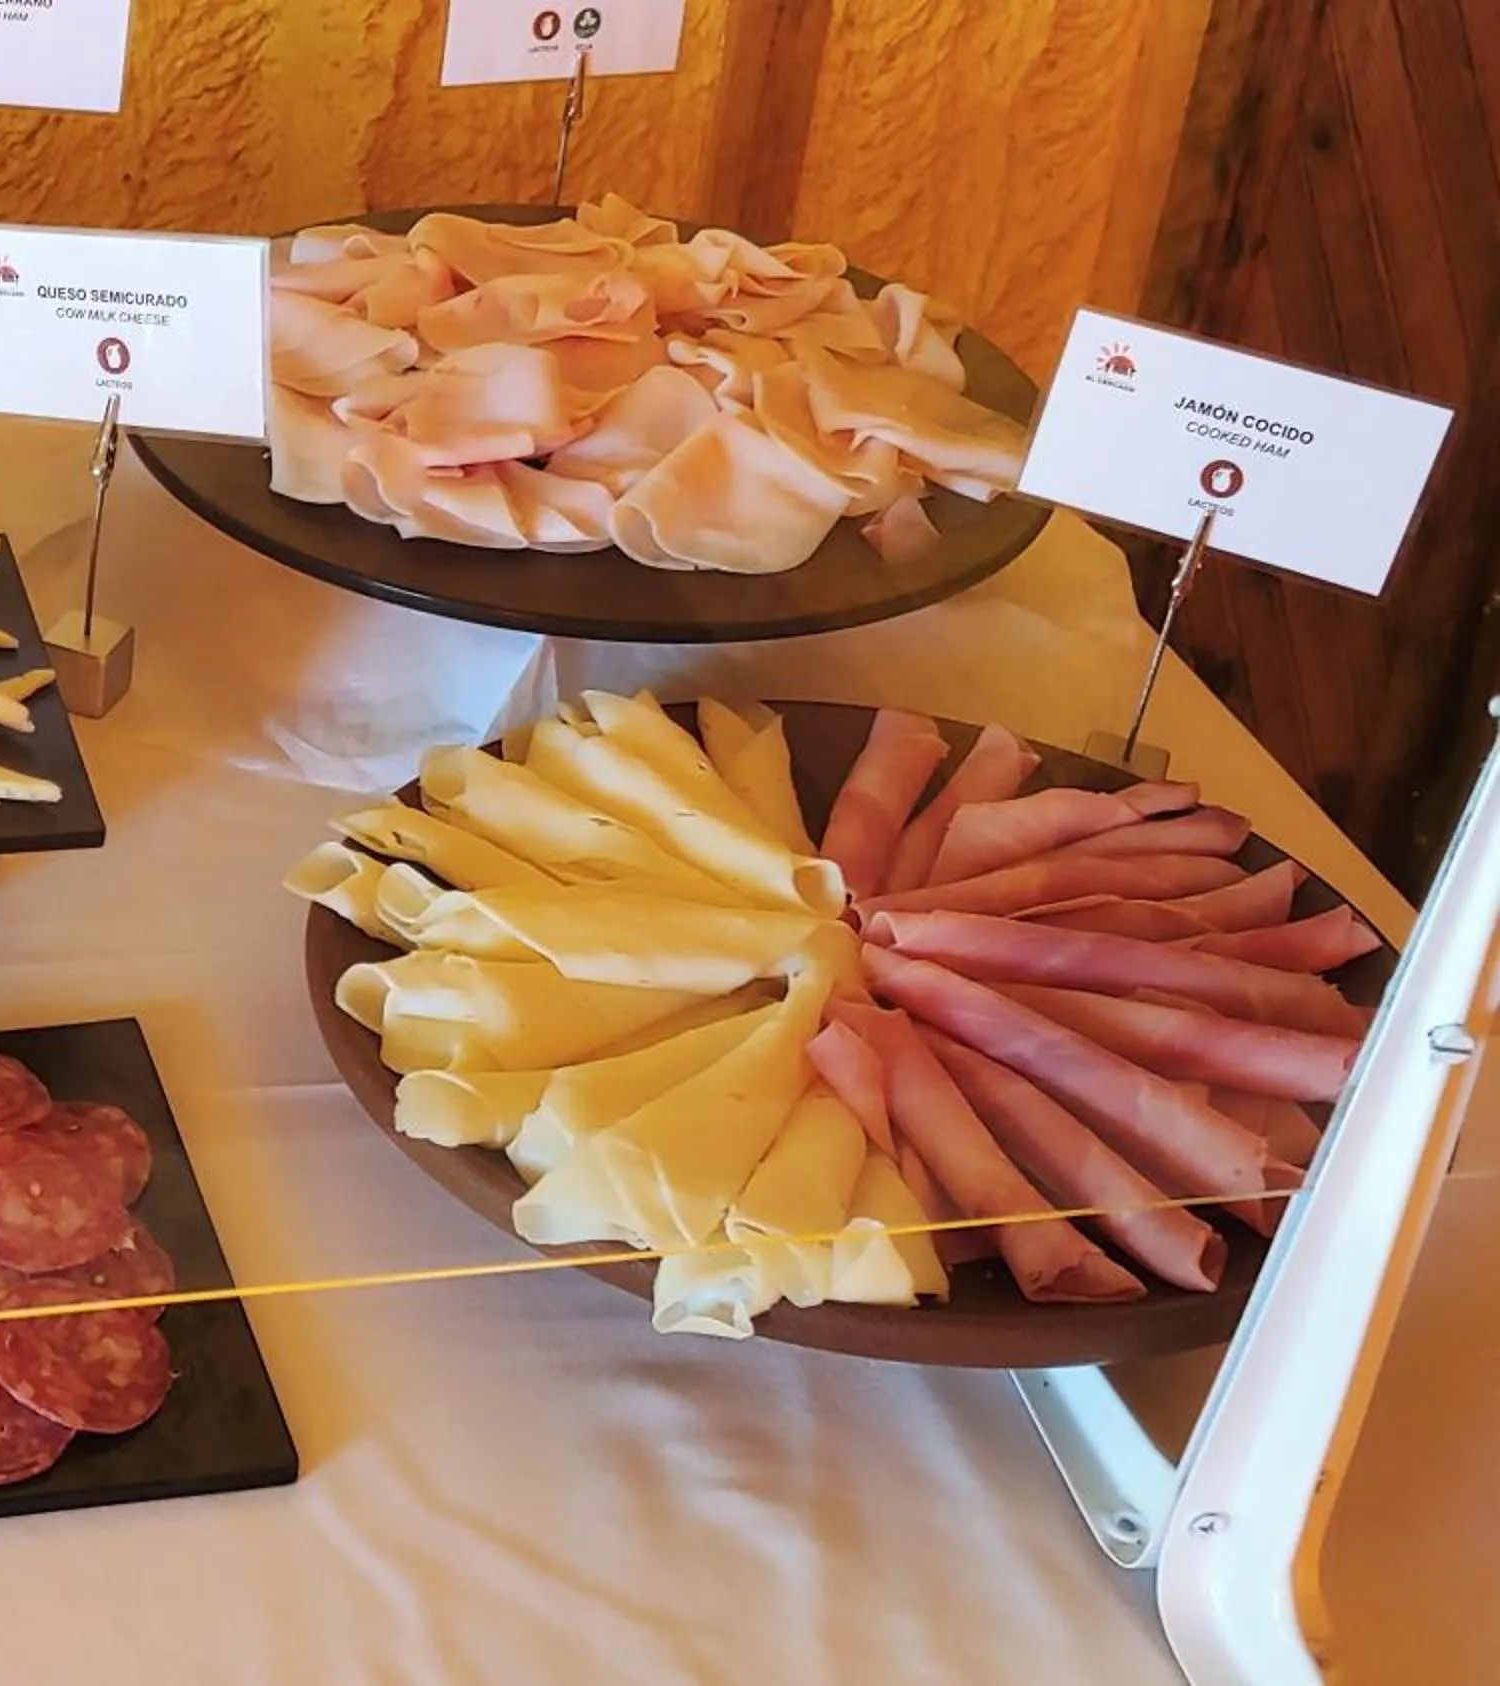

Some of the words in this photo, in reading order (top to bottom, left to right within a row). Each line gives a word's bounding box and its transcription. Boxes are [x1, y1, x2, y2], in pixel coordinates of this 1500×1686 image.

[37, 285, 87, 301] QUESO
[91, 289, 188, 309] SEMICURADO
[56, 307, 87, 319] COW
[87, 309, 117, 322] MILK
[119, 311, 171, 326] CHEESE
[1174, 396, 1239, 423] JAMÓN
[1242, 415, 1314, 445] COCIDO
[1186, 421, 1252, 448] COOKED
[1253, 441, 1291, 459] HAM
